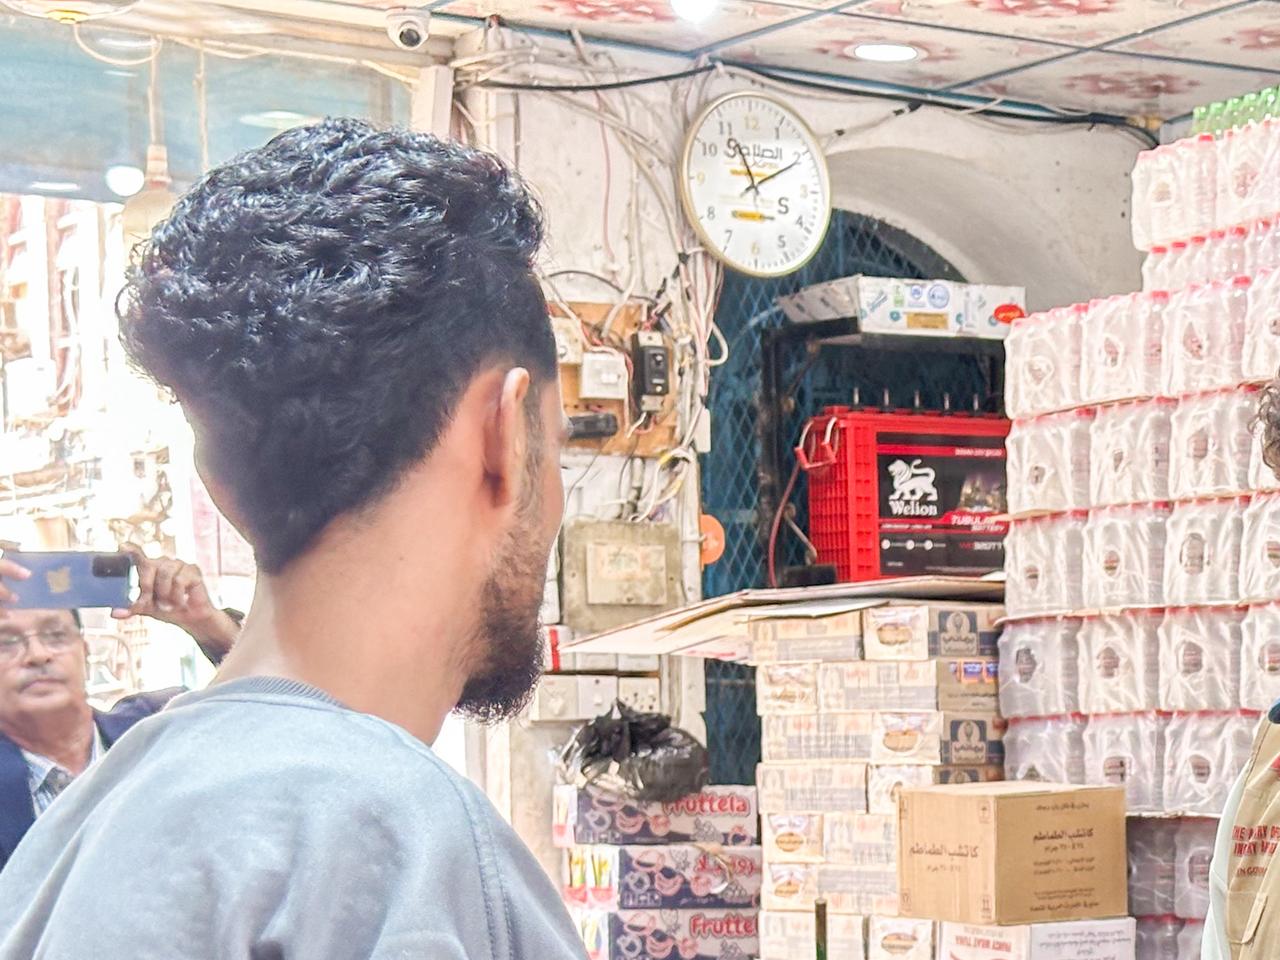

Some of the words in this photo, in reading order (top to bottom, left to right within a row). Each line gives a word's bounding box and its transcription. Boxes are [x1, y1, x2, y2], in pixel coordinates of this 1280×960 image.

[719, 120, 733, 136] 11
[702, 142, 718, 157] 10
[707, 206, 716, 220] 8
[724, 229, 733, 244] 7
[888, 500, 938, 516] Welion
[662, 792, 750, 817] Fruttela
